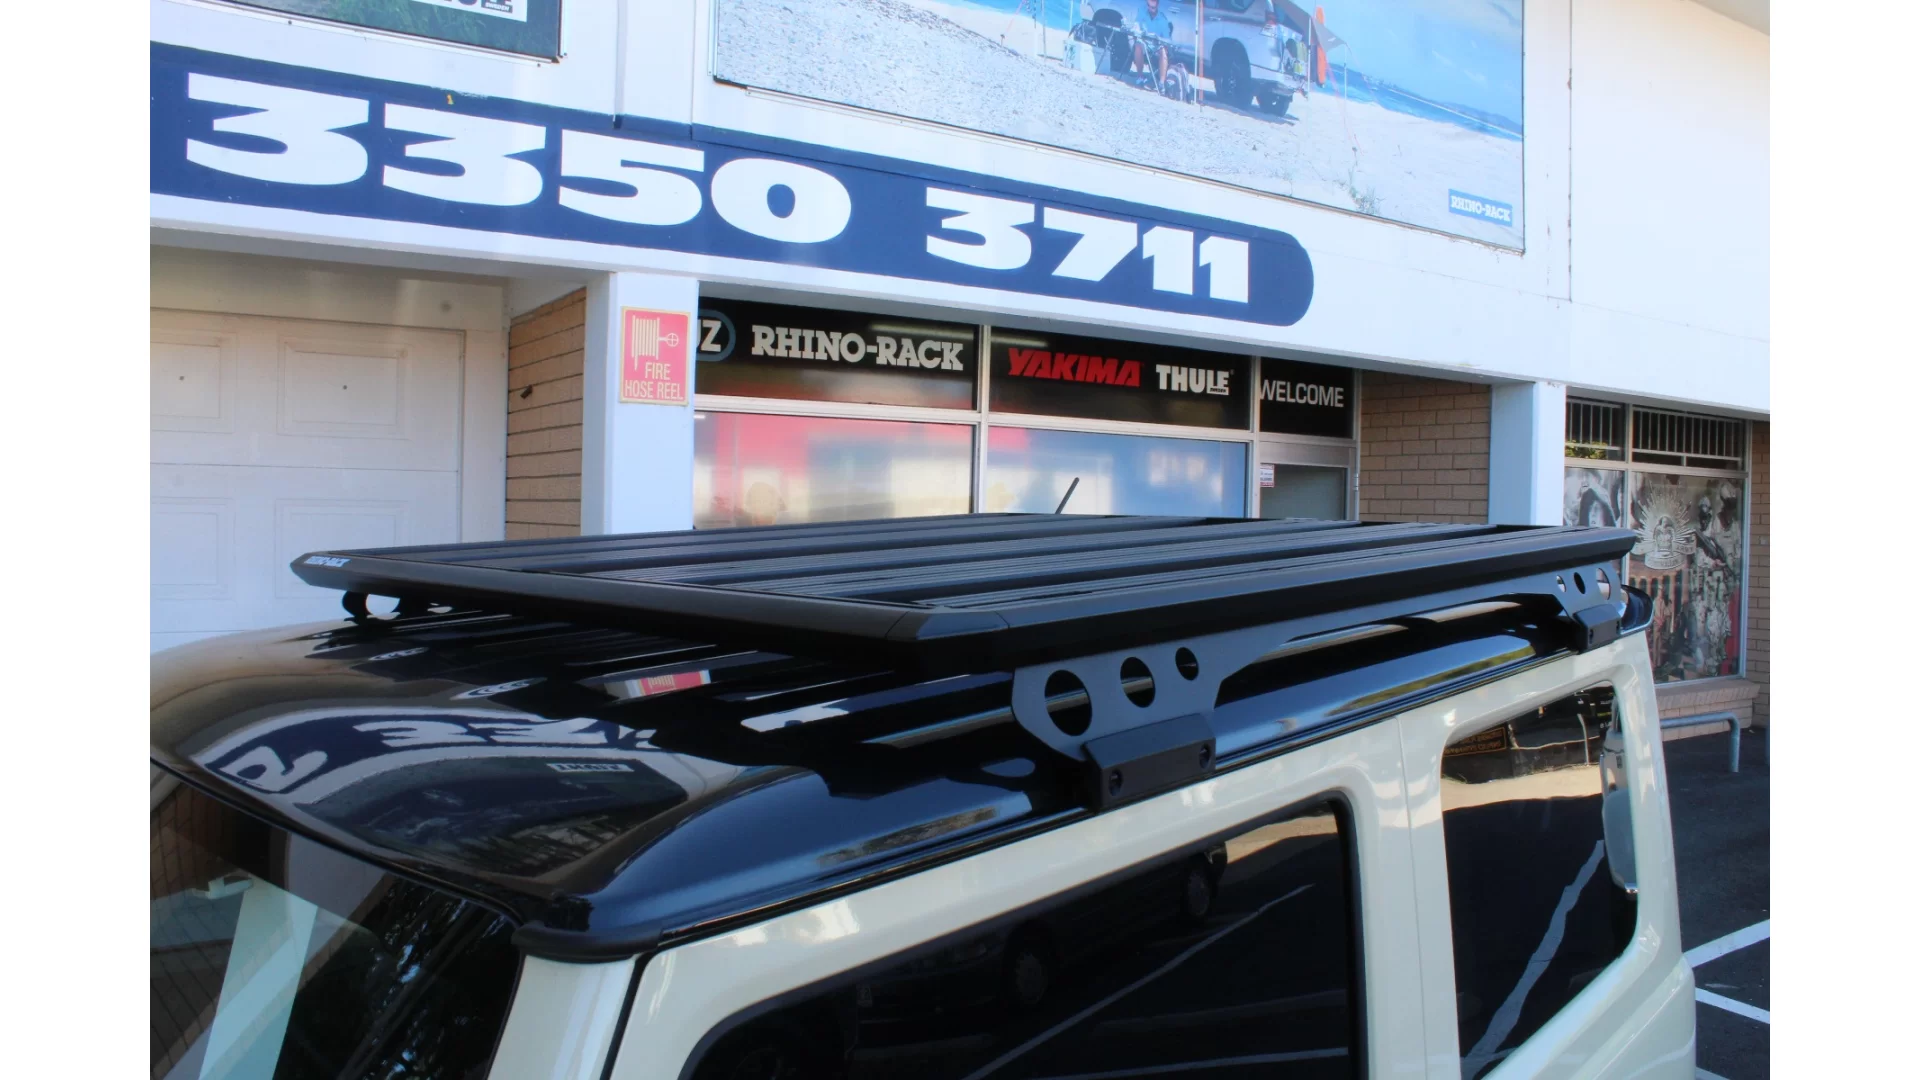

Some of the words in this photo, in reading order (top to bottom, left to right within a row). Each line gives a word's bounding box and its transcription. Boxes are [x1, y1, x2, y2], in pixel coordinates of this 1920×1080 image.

[186, 72, 852, 244] 3350
[926, 187, 1249, 303] 3711
[1451, 195, 1511, 222] RHINO-RACK
[751, 324, 964, 371] RHINO-RACK
[644, 362, 671, 380] FIRE
[1008, 347, 1141, 387] YAKIMA
[1155, 363, 1230, 395] THULE
[624, 379, 654, 399] HOSE
[657, 382, 684, 400] REEL
[1259, 379, 1344, 408] WELCOME
